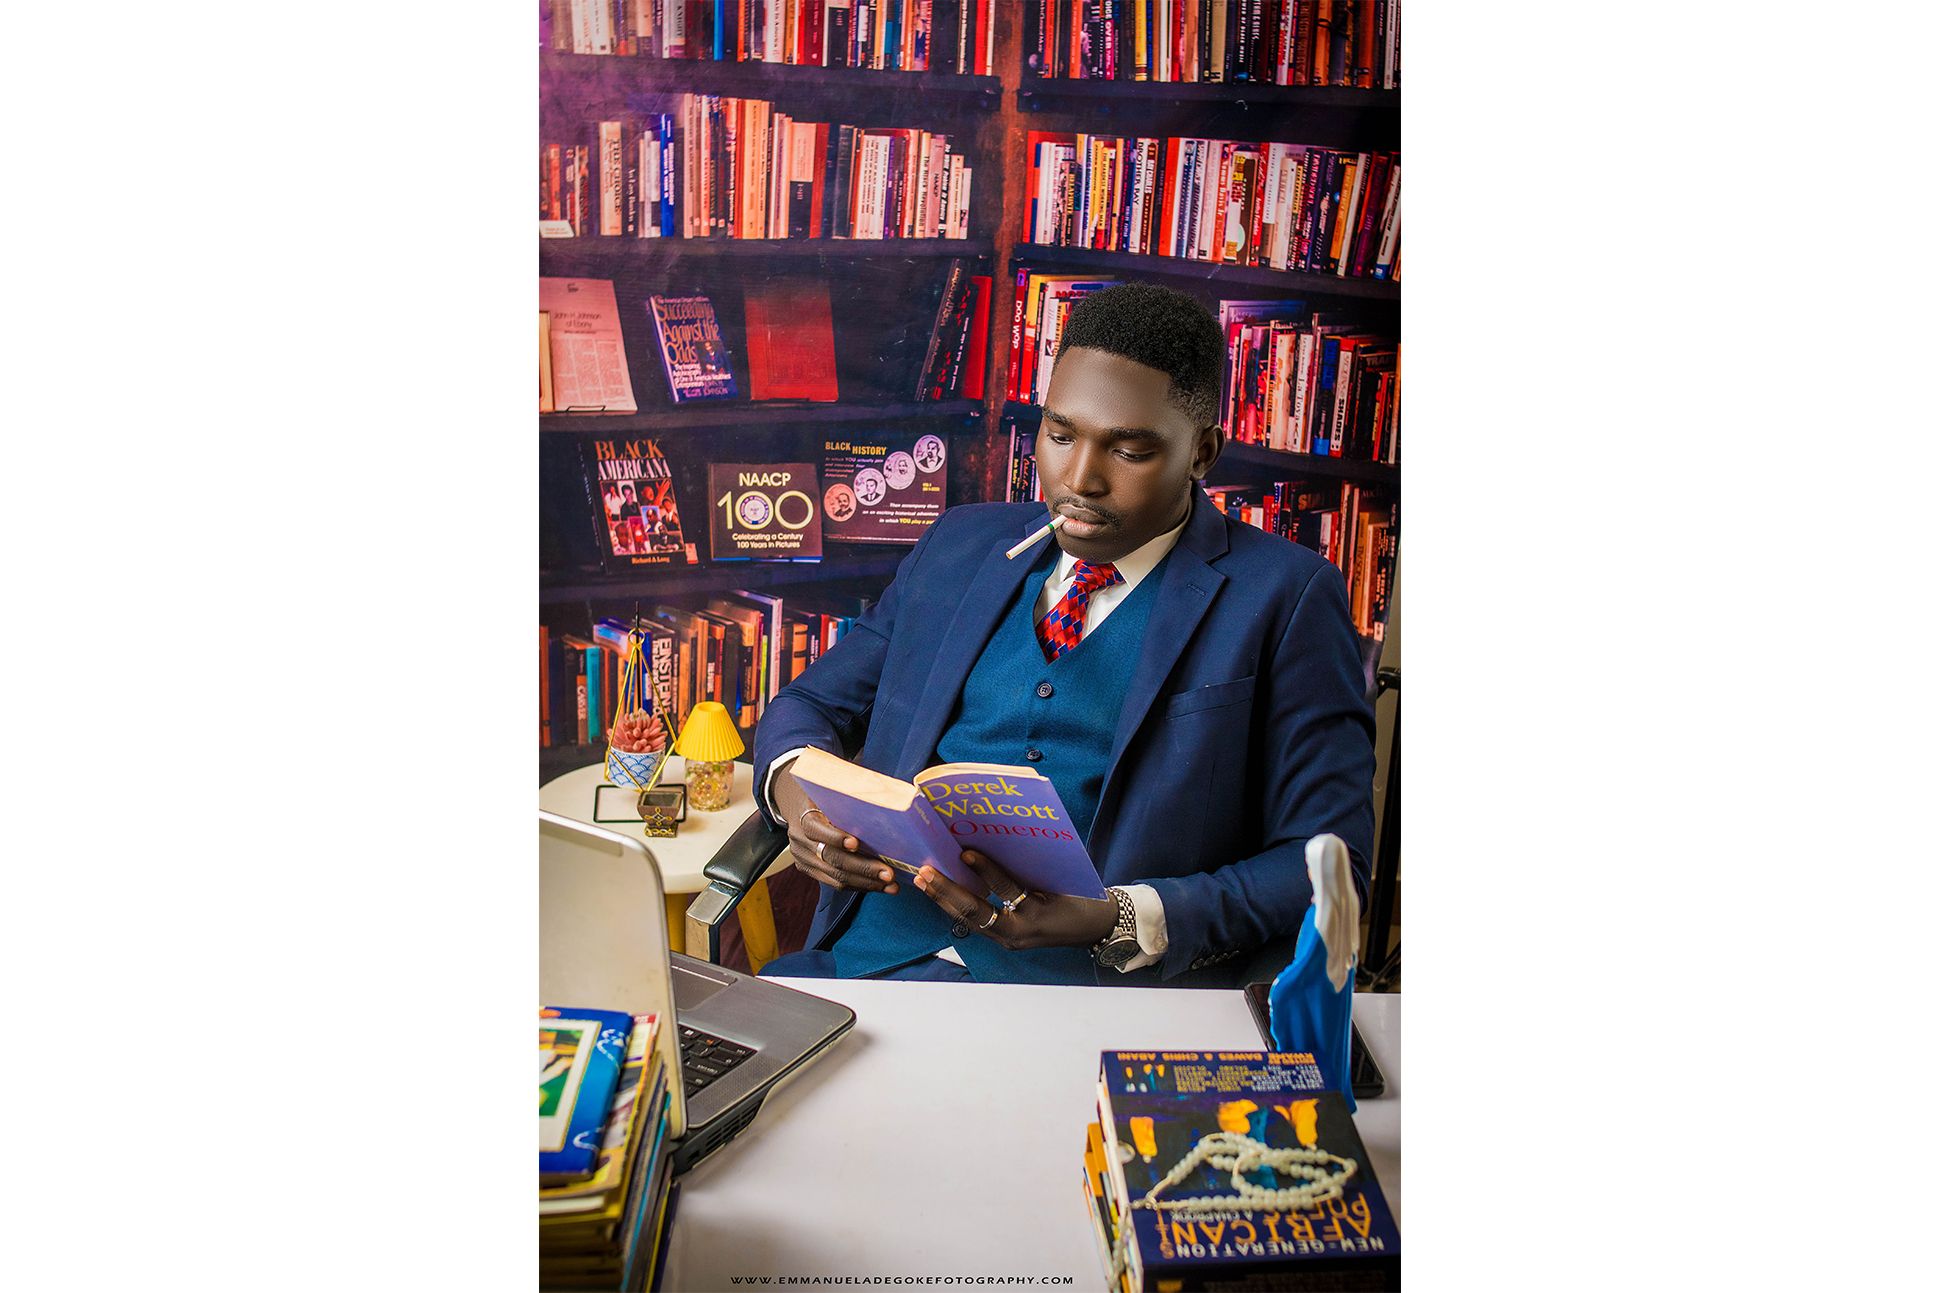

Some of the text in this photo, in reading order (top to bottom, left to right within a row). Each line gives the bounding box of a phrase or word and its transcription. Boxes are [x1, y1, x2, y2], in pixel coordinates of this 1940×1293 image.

[1134, 142, 1144, 185] BROTHER
[1146, 160, 1155, 170] RAY
[613, 167, 621, 214] CHOICE
[1144, 170, 1154, 194] CHARLES
[1066, 173, 1076, 216] BELAFONTE
[919, 191, 928, 226] Revolution
[655, 302, 715, 325] Succeeding
[664, 318, 720, 346] Against the
[666, 340, 698, 365] Odds
[1334, 398, 1345, 442] SHADES
[595, 440, 664, 460] BLACK
[825, 441, 887, 456] BLACK HISTORY
[598, 458, 672, 480] AMERICANA
[738, 472, 791, 486] NAACP
[717, 490, 814, 530] 100
[732, 532, 770, 542] Celebrating
[778, 532, 804, 542] Century
[921, 777, 1024, 802] Derek
[934, 797, 1060, 821] Walcott
[950, 820, 1074, 841] Omeros
[1118, 1052, 1156, 1061] ABANI
[1162, 1052, 1199, 1062] CHRIS
[1170, 1216, 1372, 1247] AFRICAN
[1175, 1236, 1385, 1259] NEW-GENERATION
